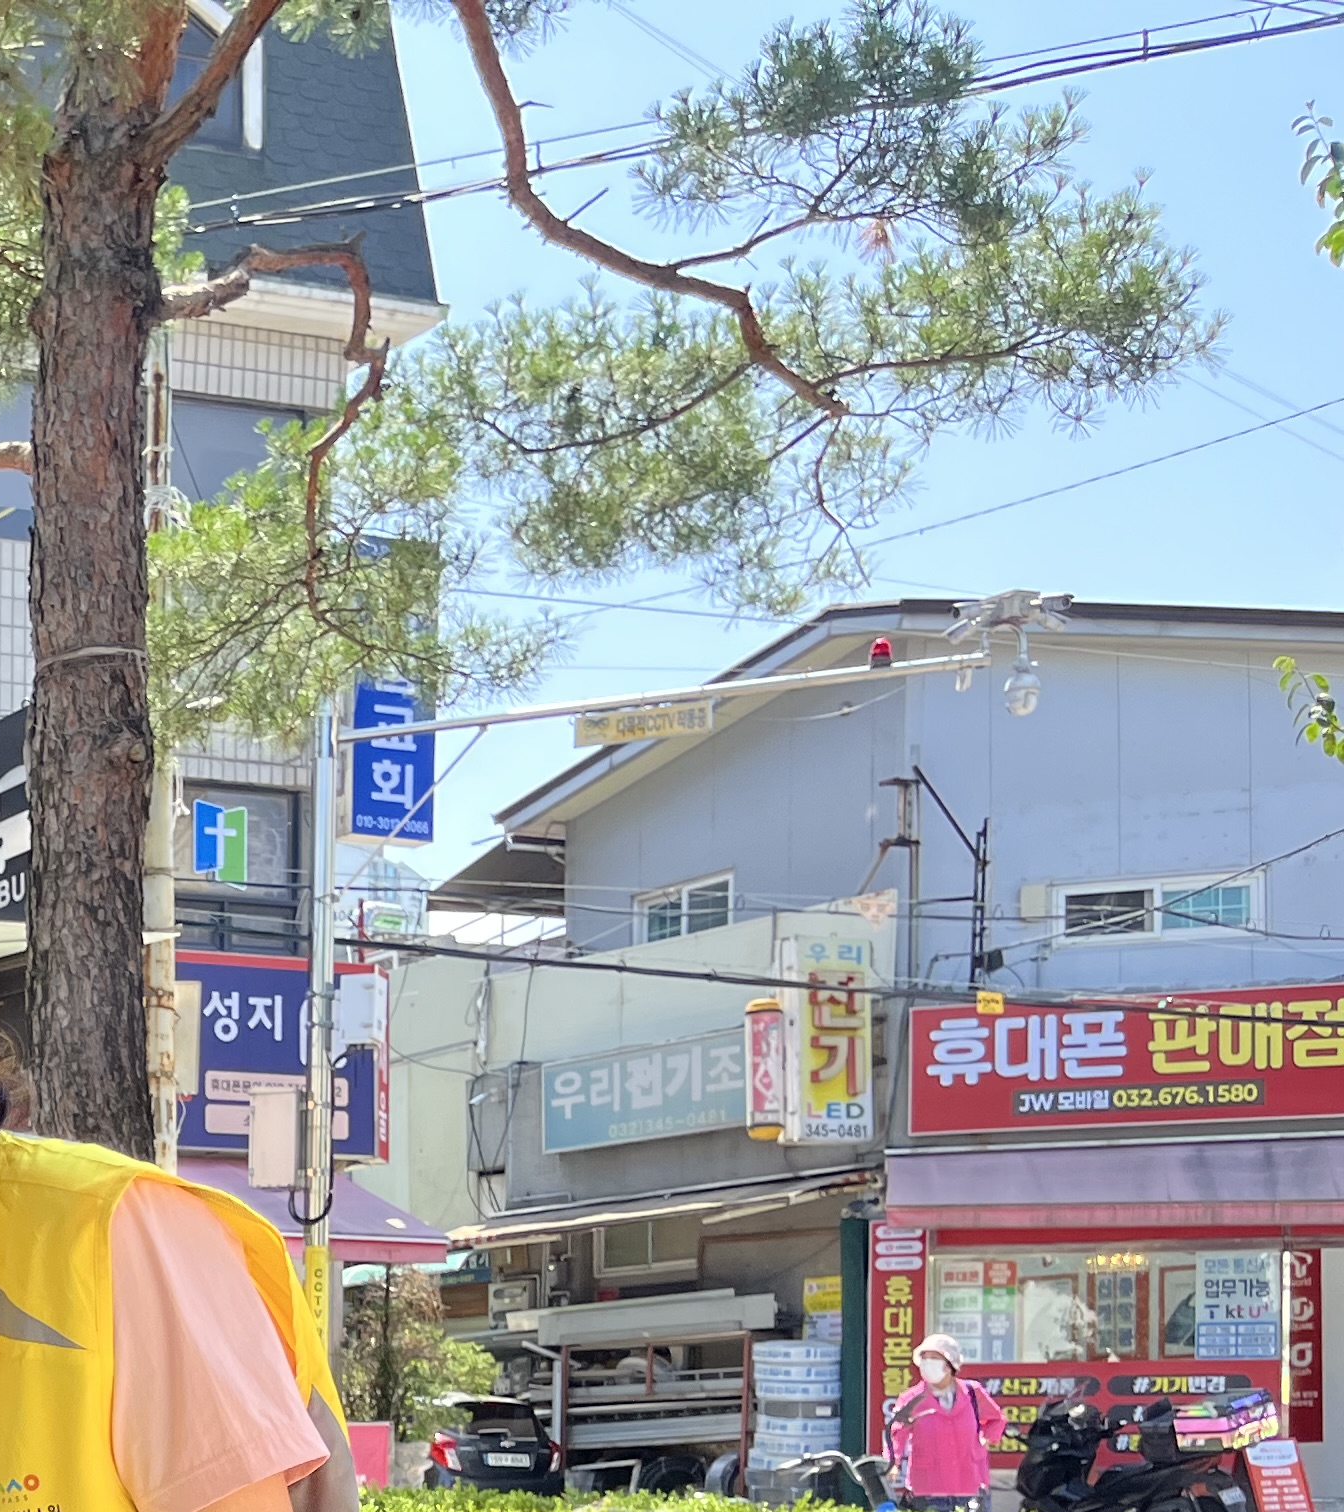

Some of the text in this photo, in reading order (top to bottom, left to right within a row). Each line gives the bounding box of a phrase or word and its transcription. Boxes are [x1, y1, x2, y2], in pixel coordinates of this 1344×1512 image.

[805, 944, 862, 965] 우리
[203, 991, 283, 1042] 성지
[926, 999, 1344, 1087] 휴대폰 판매점
[1019, 1083, 1259, 1113] JW 모바일 032.676.1580
[807, 1102, 865, 1120] LED
[805, 1122, 868, 1139] 345-0481
[314, 1268, 322, 1319] CCTV
[1204, 1279, 1270, 1298] 업무가능
